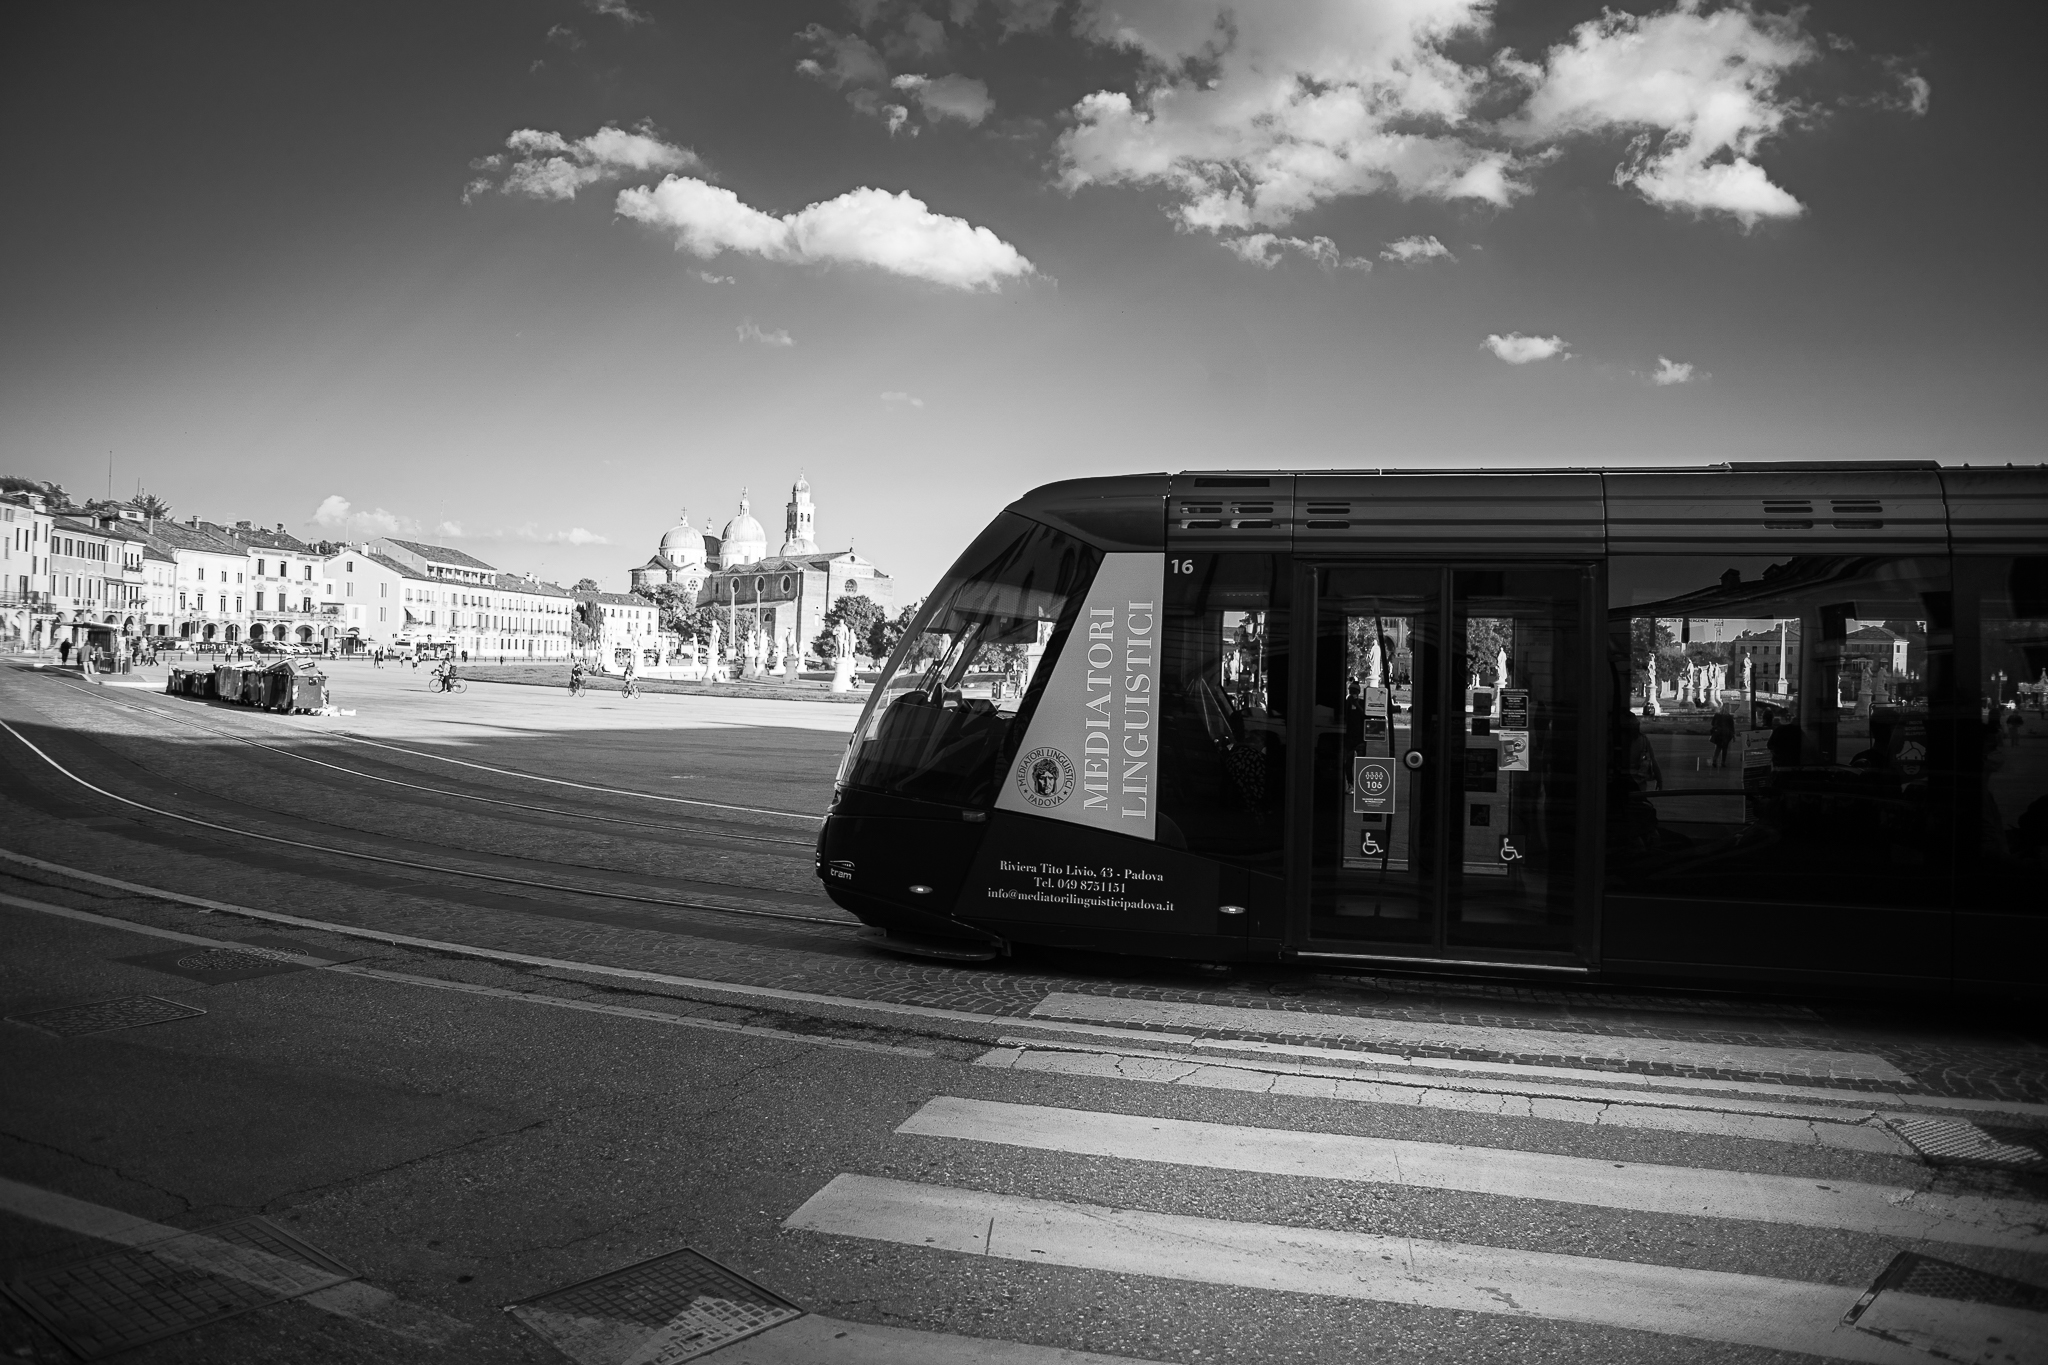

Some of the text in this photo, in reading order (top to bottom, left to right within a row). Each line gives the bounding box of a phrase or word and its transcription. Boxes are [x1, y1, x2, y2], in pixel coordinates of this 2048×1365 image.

[1171, 559, 1194, 575] 16
[1083, 606, 1115, 811] MEDIATORI
[1121, 600, 1154, 820] LINGUISTICI
[1018, 748, 1074, 790] MEDIATORI LINGUISTICI
[1366, 781, 1383, 789] 106
[1027, 792, 1064, 807] PADOVA
[830, 868, 852, 880] tram
[999, 860, 1037, 873] Riviera
[1040, 862, 1063, 875] Tito
[1066, 865, 1097, 878] Livio,
[1100, 867, 1113, 878] 43
[1124, 869, 1163, 882] Padova
[1034, 877, 1126, 893] Tel. 049 8751151
[988, 888, 1175, 912] info@mediatorilinguisticipadova.it
